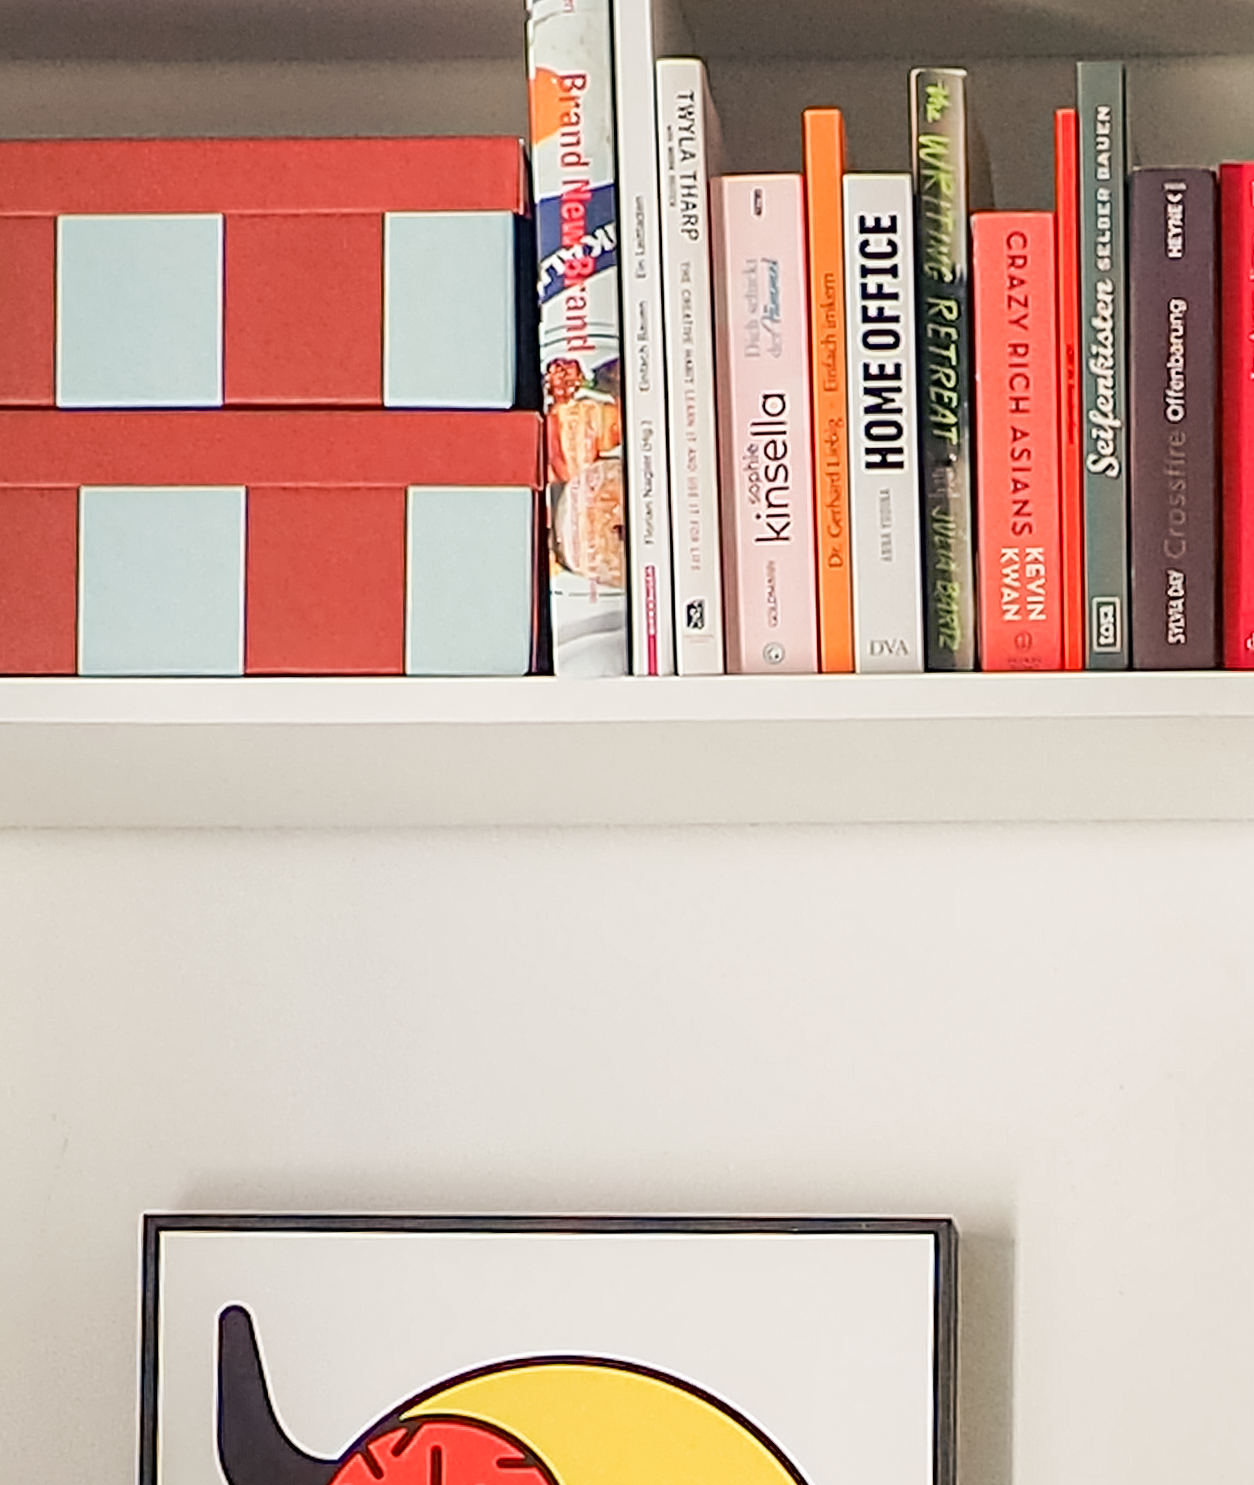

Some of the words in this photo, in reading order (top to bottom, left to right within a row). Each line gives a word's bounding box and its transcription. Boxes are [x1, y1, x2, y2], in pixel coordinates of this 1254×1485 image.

[559, 73, 590, 167] Brand
[678, 90, 695, 163] TWYLA
[562, 180, 592, 248] New
[680, 170, 699, 241] THARP
[919, 134, 960, 284] WRITING
[564, 254, 597, 353] Brand
[858, 213, 902, 351] OFFICE
[1006, 231, 1030, 331] CRAZY
[926, 296, 959, 445] RETREAT
[1008, 343, 1031, 413] RICH
[1086, 278, 1123, 480] Seifenkisten
[1164, 298, 1188, 422] Offenbarung
[863, 361, 905, 470] HOME
[750, 393, 791, 544] kinsella
[1009, 425, 1034, 537] ASIANS
[999, 547, 1022, 622] KWAN
[1023, 547, 1046, 622] KEVIN
